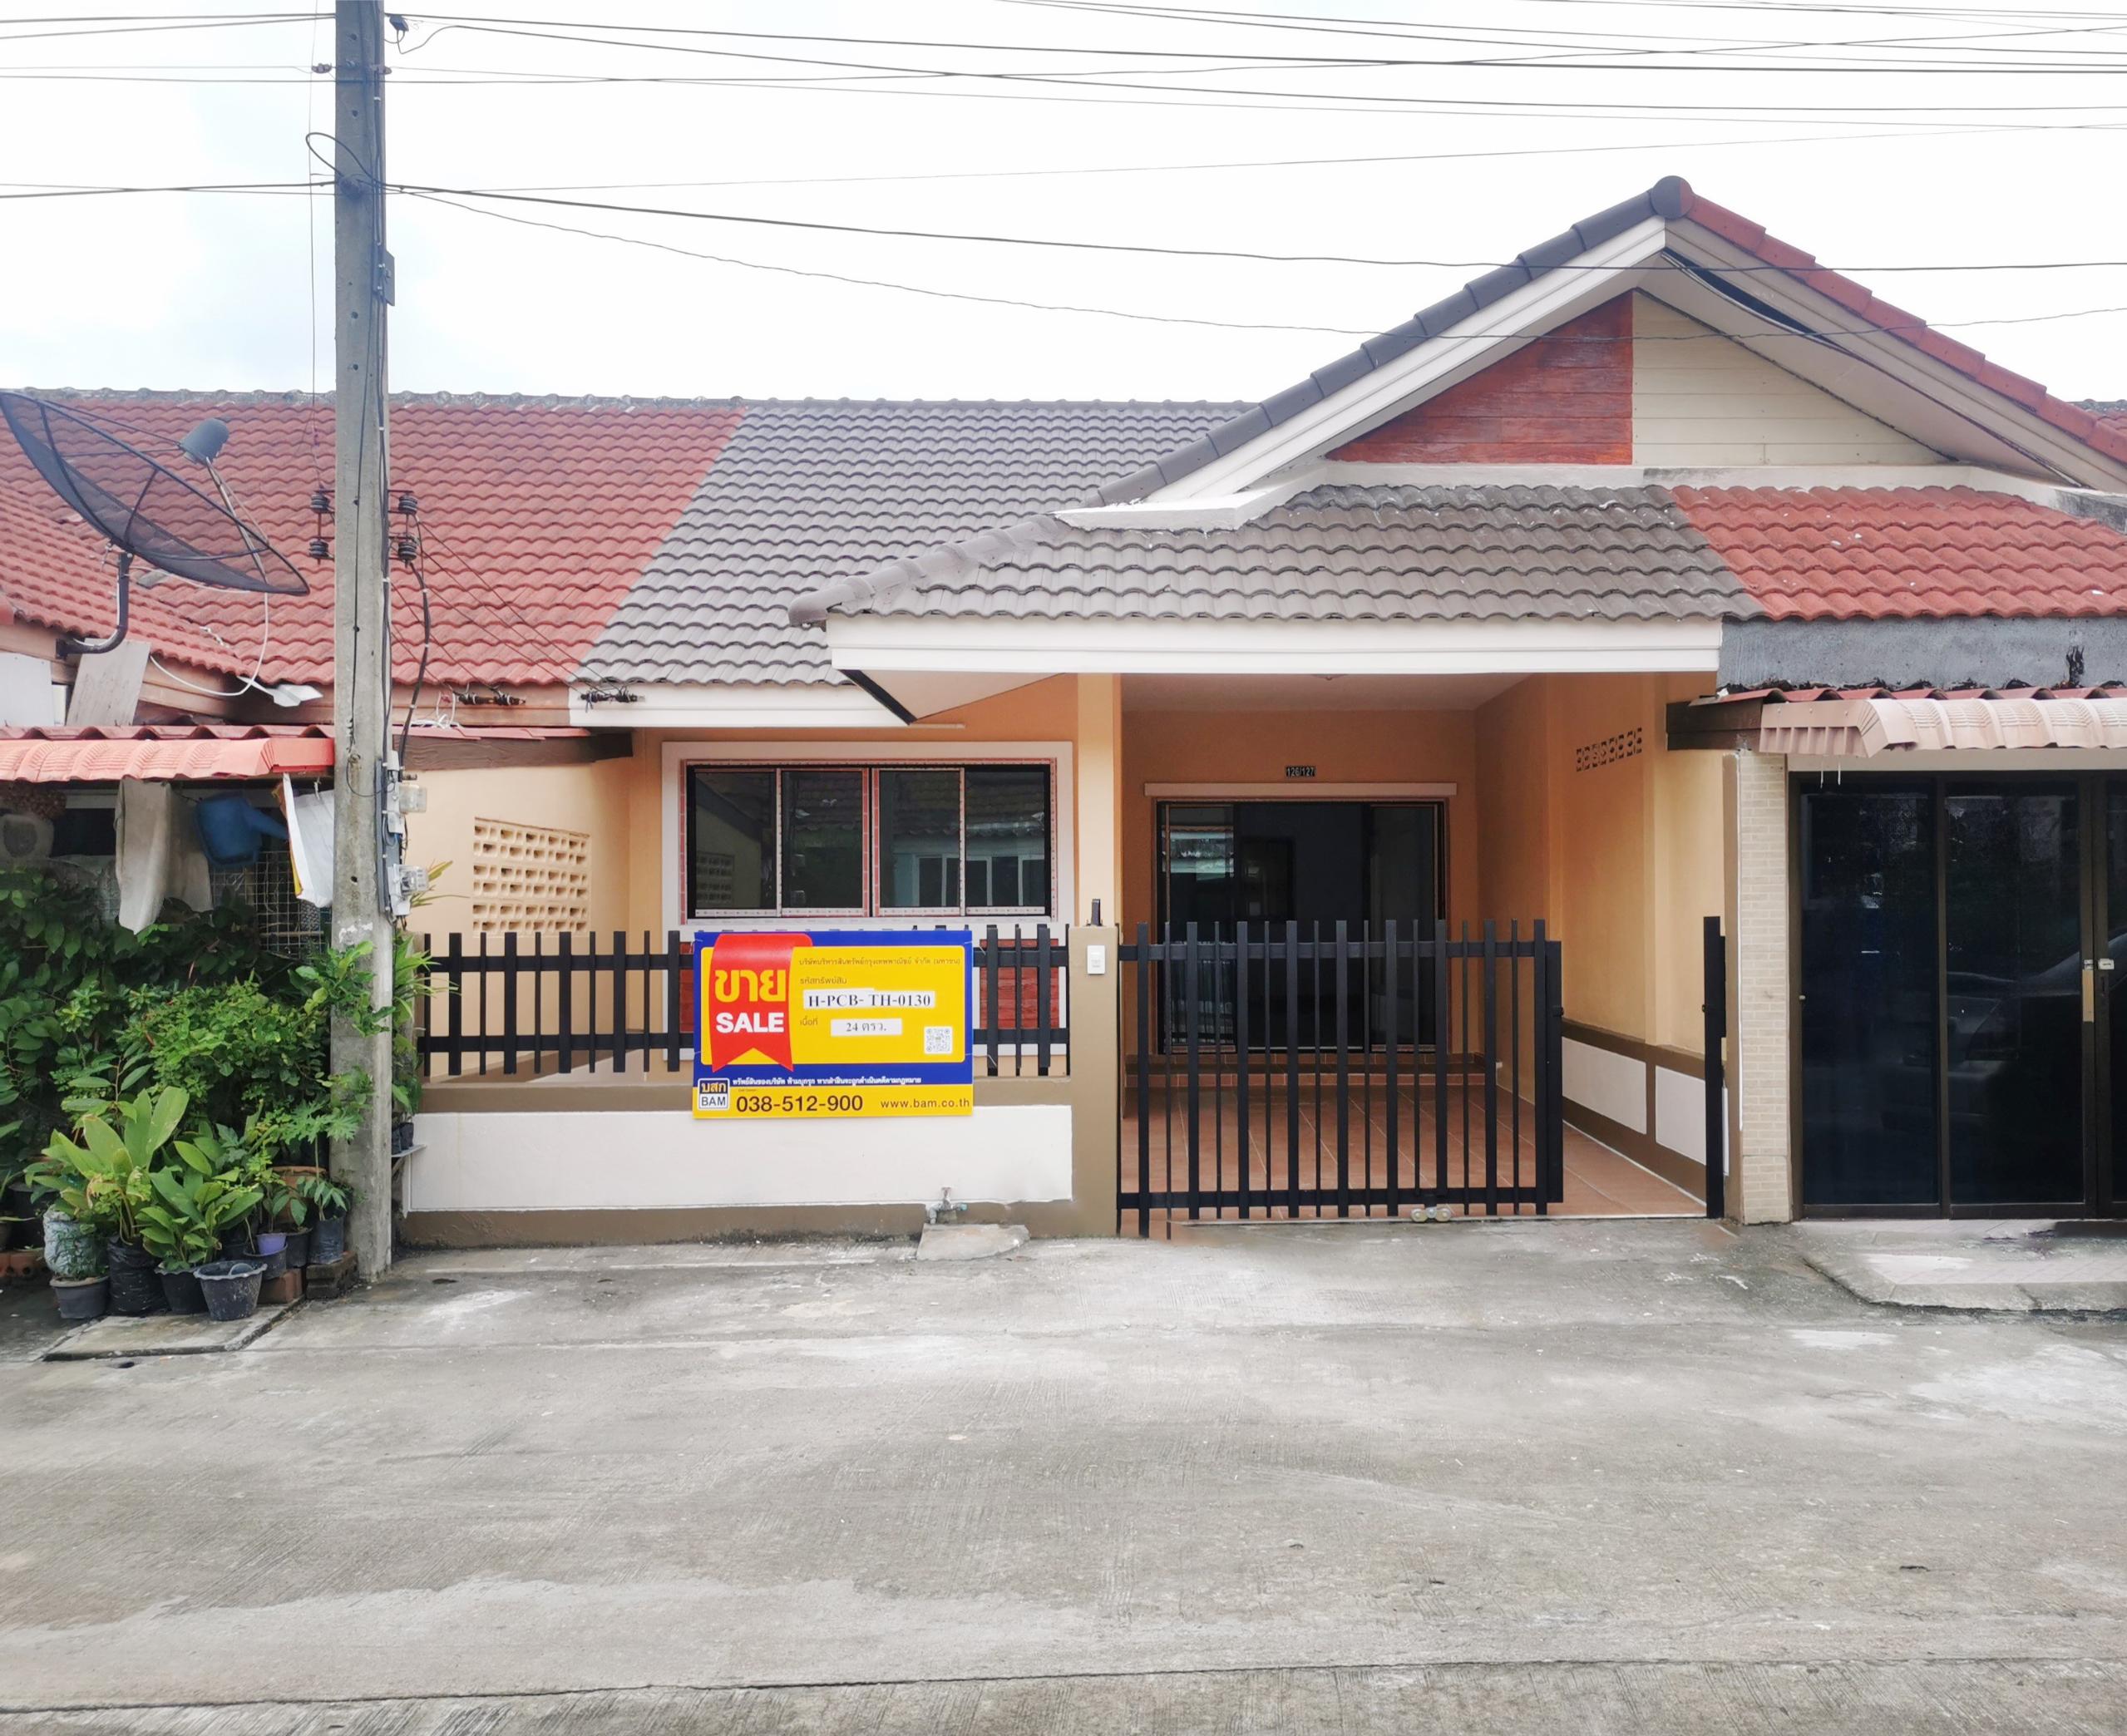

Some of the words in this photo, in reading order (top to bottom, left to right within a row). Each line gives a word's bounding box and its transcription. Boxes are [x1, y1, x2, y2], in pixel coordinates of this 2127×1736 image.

[715, 969, 786, 1003] ขาย
[716, 1012, 785, 1033] SALE
[846, 1022, 859, 1032] 24
[701, 1082, 727, 1092] บสก
[701, 1096, 726, 1107] BAM
[736, 1095, 863, 1112] 038-512-900
[881, 1097, 970, 1108] www.bam.co.th
